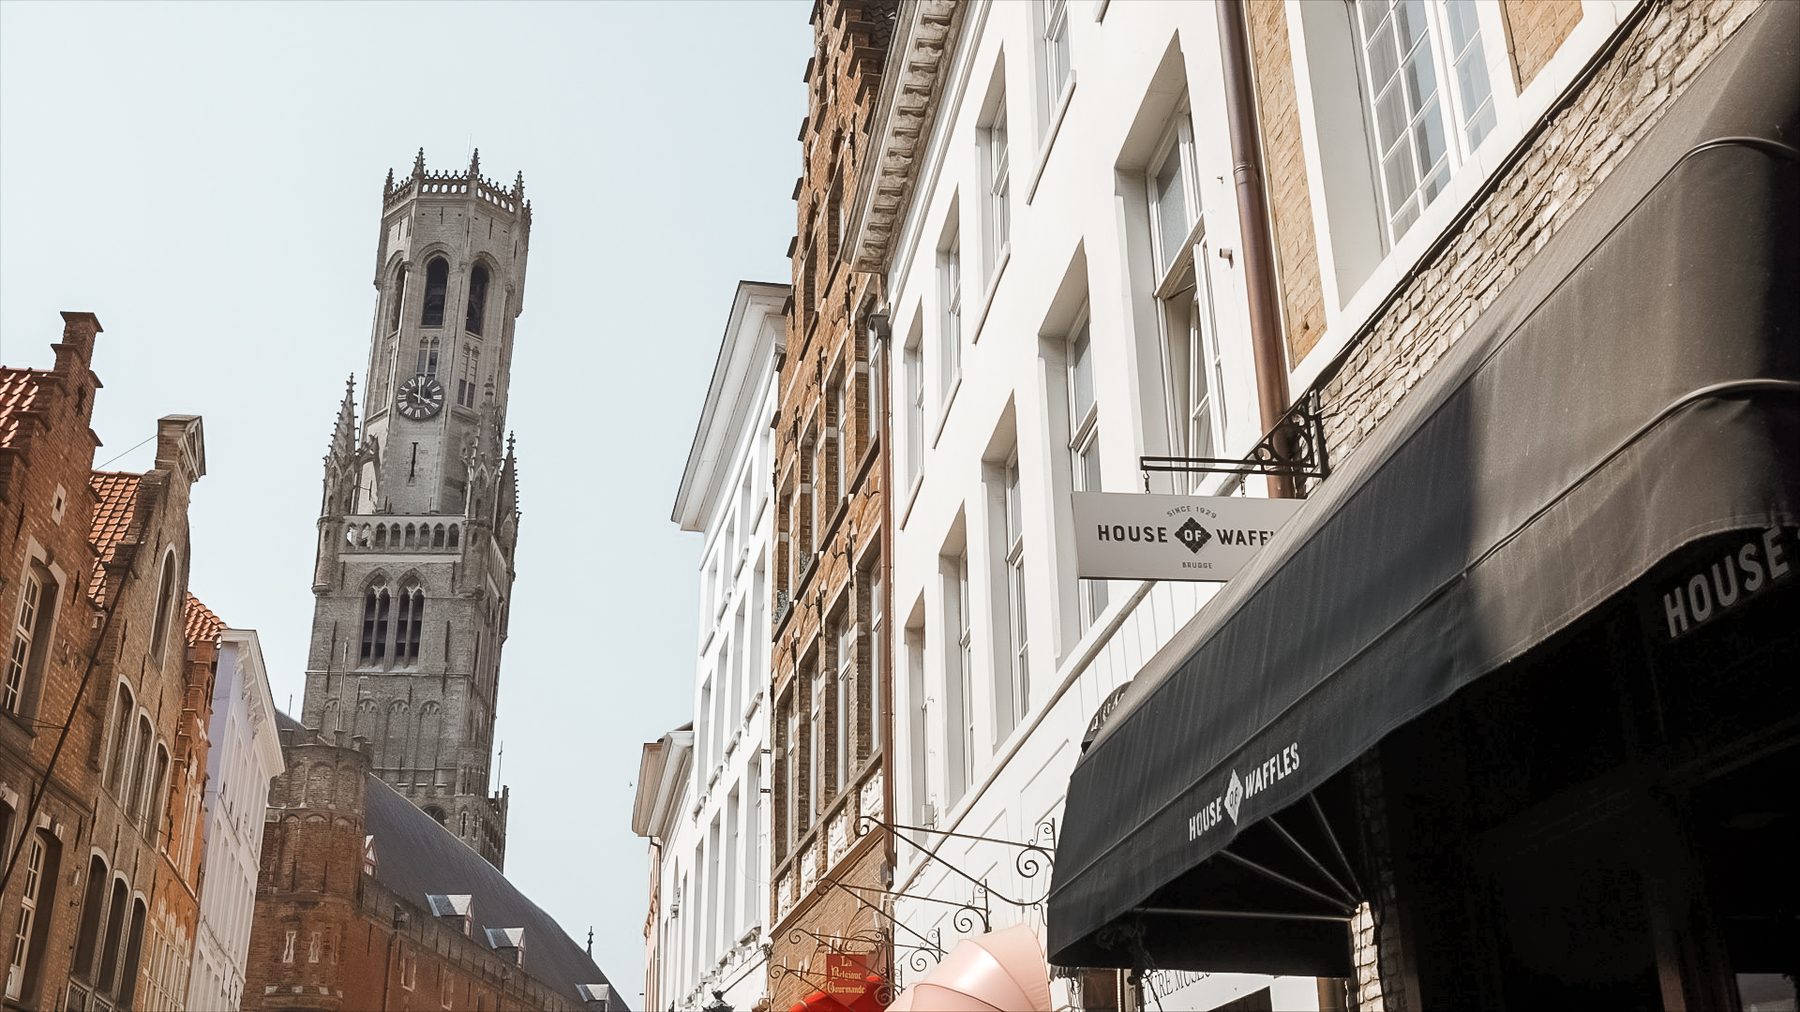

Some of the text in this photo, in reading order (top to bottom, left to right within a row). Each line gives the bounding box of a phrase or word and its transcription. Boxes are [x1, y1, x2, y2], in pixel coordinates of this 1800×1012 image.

[1167, 505, 1217, 519] SINCE 1929
[1098, 524, 1274, 546] HOUSE OF WAFF
[1182, 561, 1213, 569] BRUGGE
[1663, 525, 1790, 638] HOUSE
[1189, 742, 1300, 841] HOUSE OF WAFFLES
[841, 956, 852, 967] La
[827, 980, 866, 994] Gourmande
